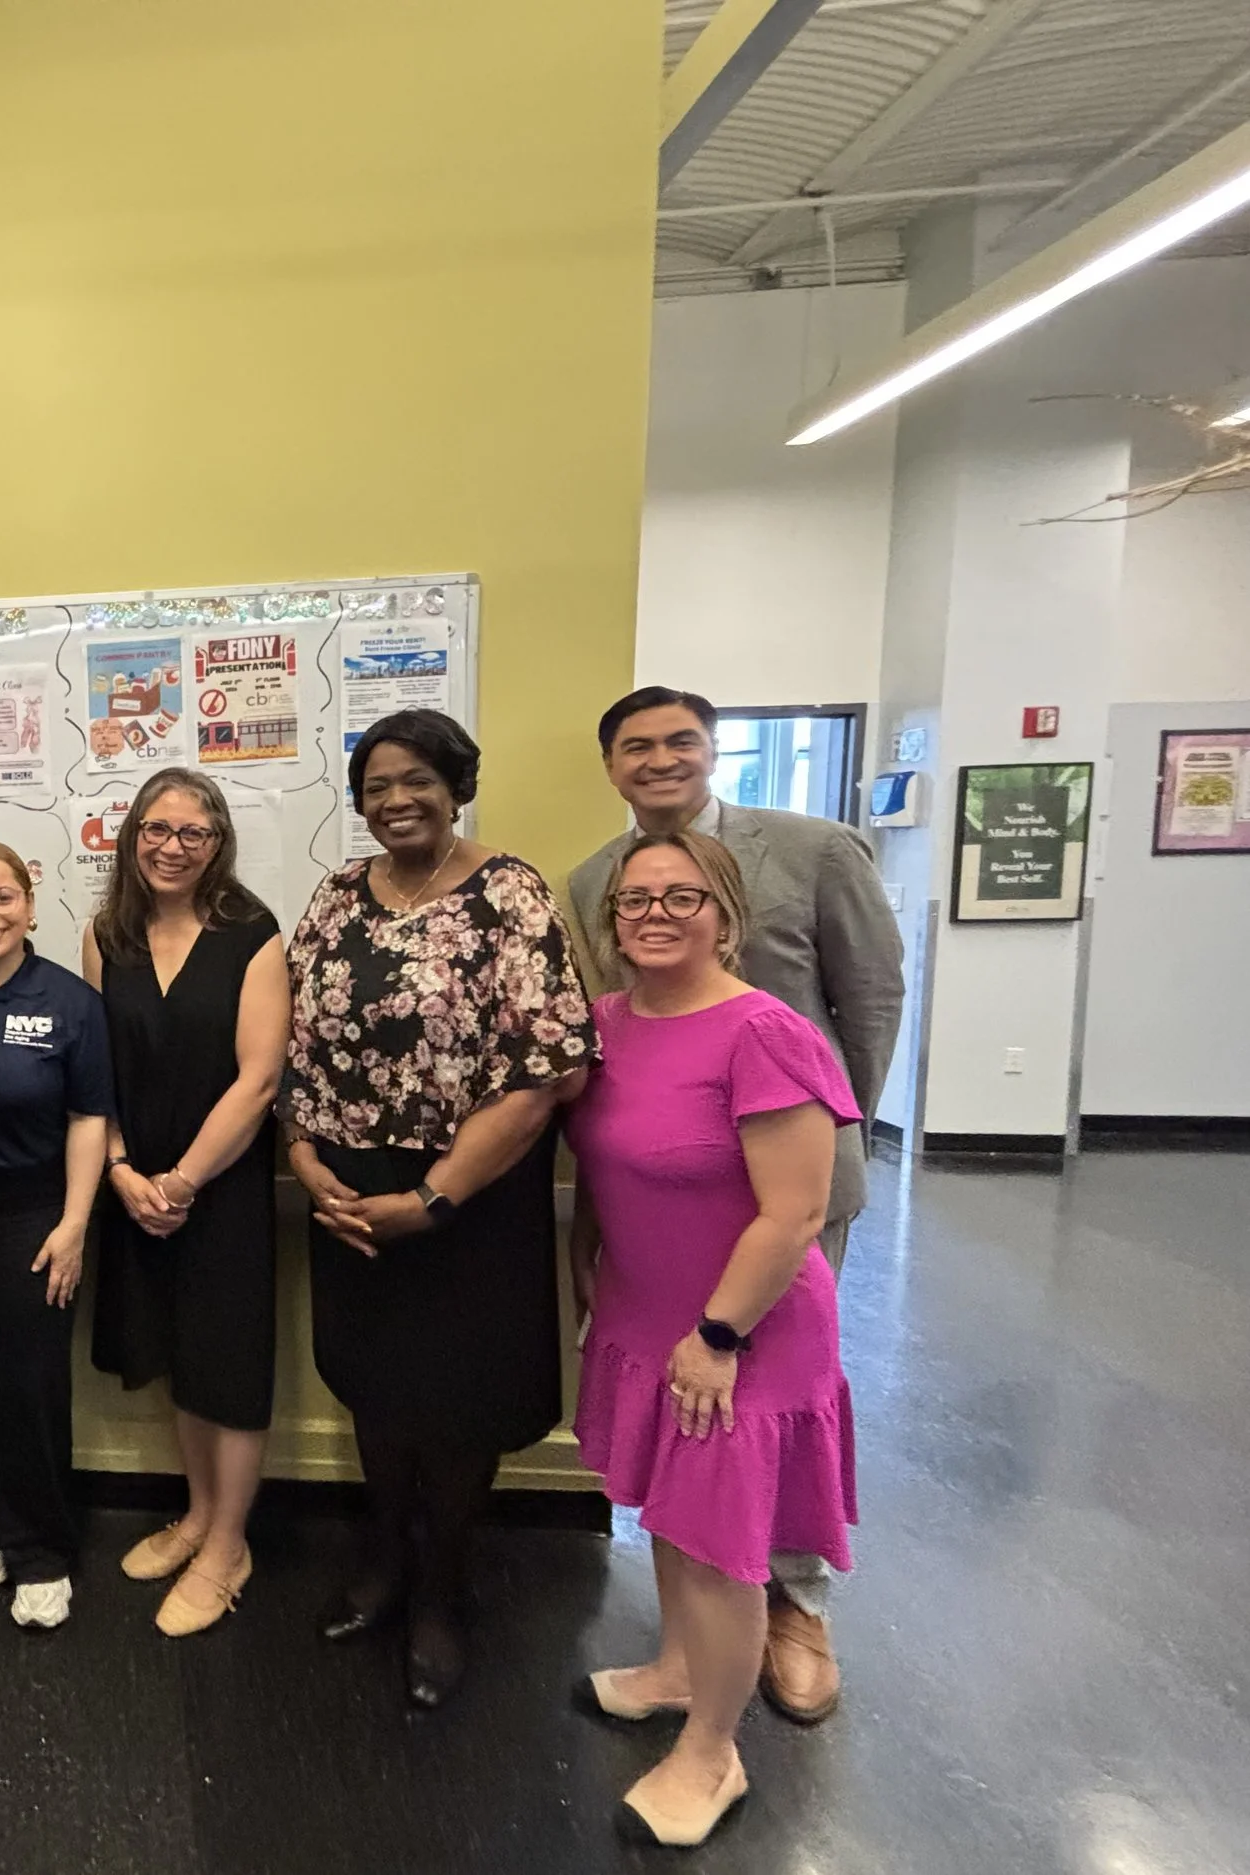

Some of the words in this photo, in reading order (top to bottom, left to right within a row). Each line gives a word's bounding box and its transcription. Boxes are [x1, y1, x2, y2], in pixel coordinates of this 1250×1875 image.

[227, 636, 277, 661] FDNY
[209, 661, 282, 674] PRESENTATION
[987, 828, 1017, 838] Mind
[1018, 828, 1029, 837] &
[990, 862, 1025, 872] Reveal
[1026, 861, 1053, 871] Your
[6, 1014, 53, 1033] NYC
